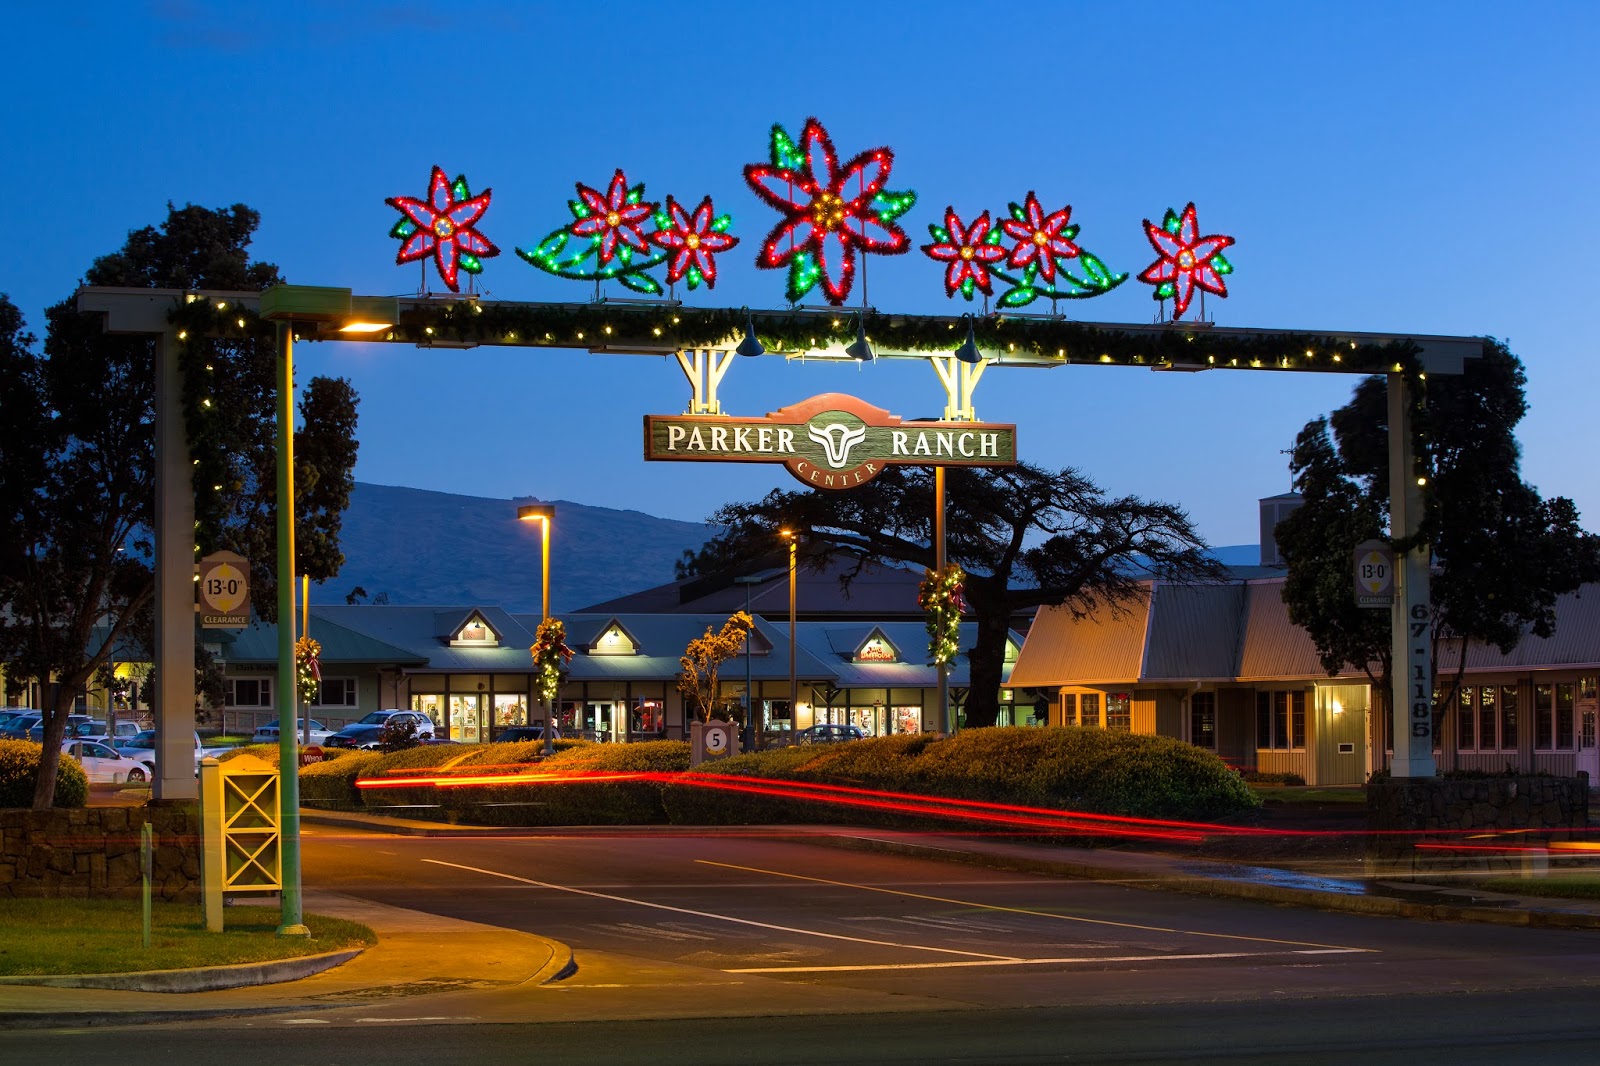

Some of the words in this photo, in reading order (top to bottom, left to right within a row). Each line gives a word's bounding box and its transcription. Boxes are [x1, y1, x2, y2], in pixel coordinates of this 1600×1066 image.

[667, 425, 796, 453] PARKER
[891, 431, 999, 458] RANCH
[797, 462, 878, 488] CENTER
[204, 615, 246, 624] CLEARANCE
[1410, 604, 1430, 738] 67-1185
[712, 733, 720, 747] 5
